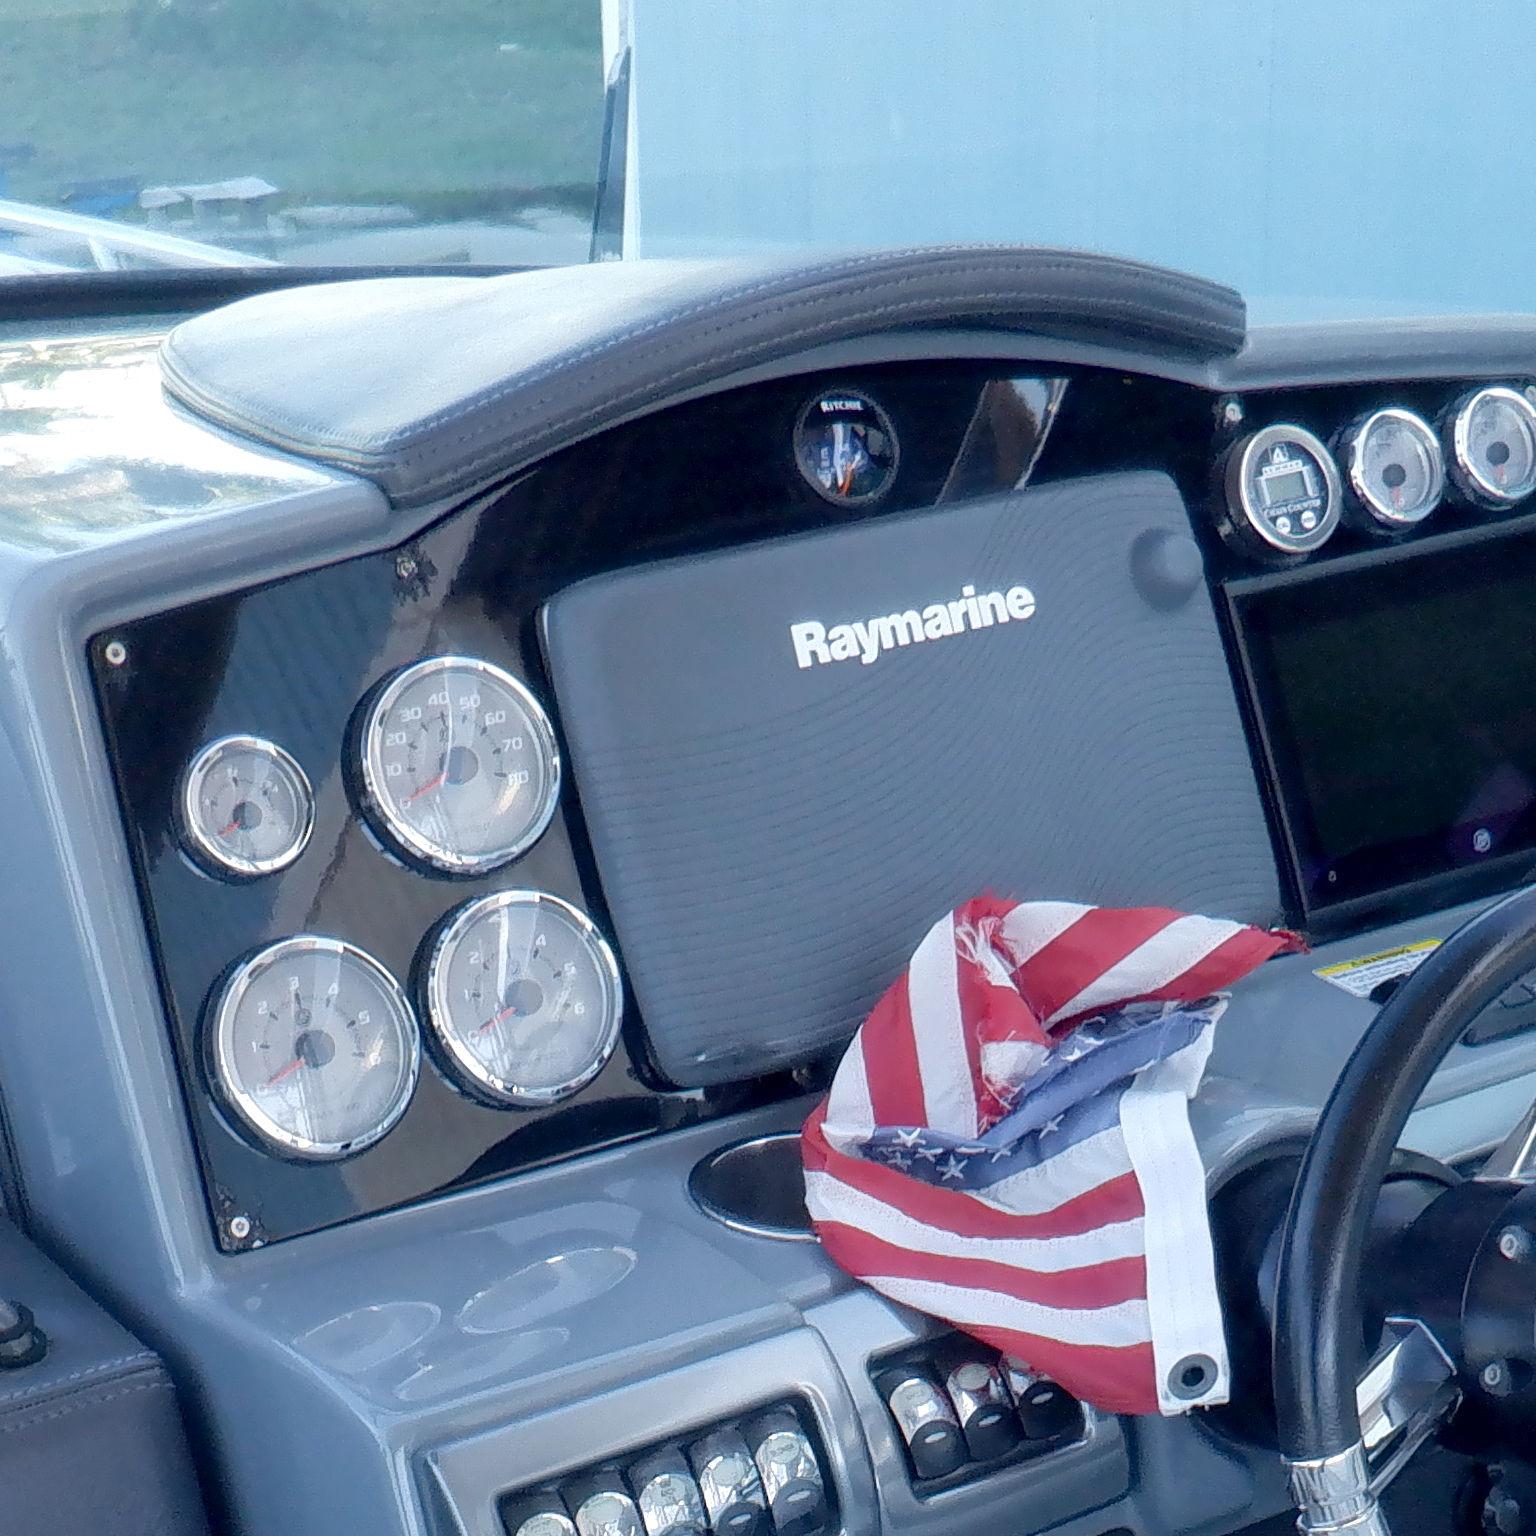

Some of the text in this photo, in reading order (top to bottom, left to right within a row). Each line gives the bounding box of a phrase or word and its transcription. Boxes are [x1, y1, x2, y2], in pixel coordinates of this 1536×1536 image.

[791, 585, 1036, 668] Raymarine
[428, 692, 449, 705] 40
[459, 695, 481, 709] 50
[400, 707, 421, 722] 30
[485, 711, 505, 726] 60
[386, 732, 406, 747] 20
[503, 738, 522, 752] 70
[386, 764, 402, 776] 10
[328, 982, 338, 996] 4
[257, 1001, 268, 1014] 2
